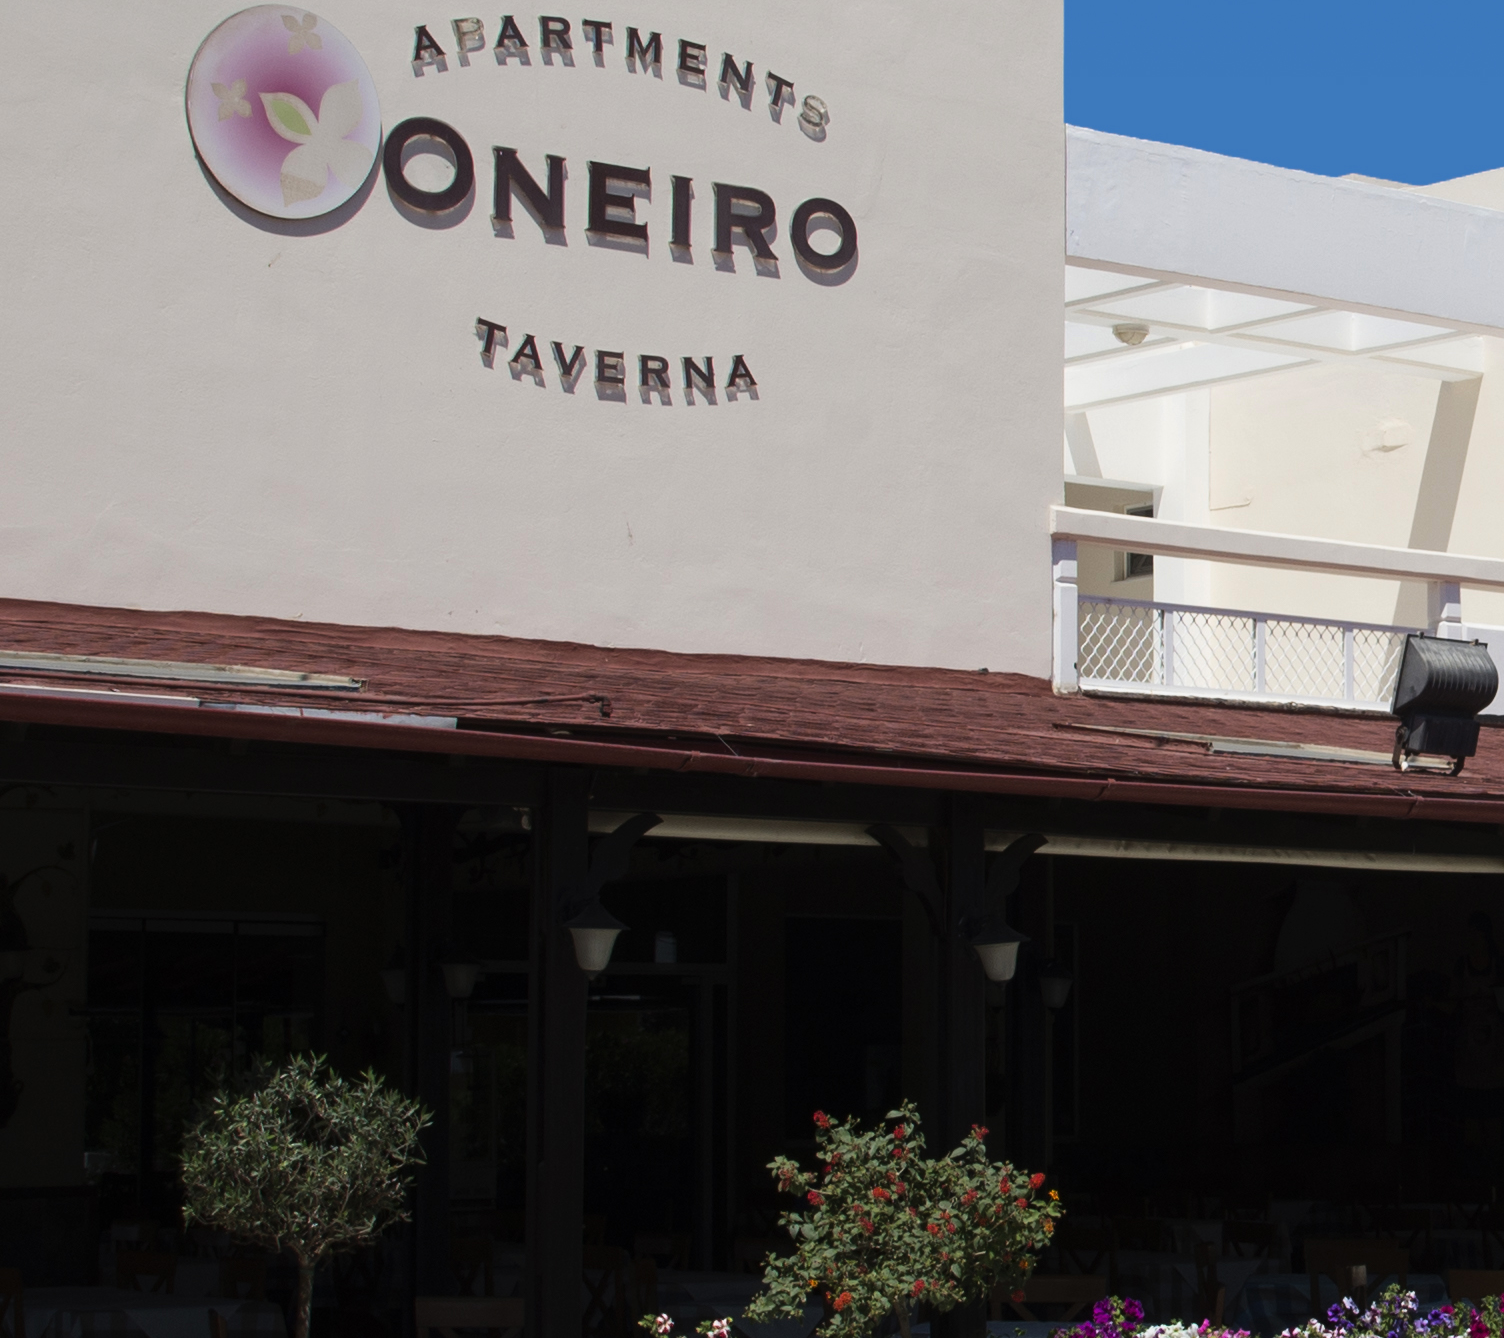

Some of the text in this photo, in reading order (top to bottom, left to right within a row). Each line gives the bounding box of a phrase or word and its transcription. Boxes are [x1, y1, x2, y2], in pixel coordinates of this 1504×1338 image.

[412, 14, 828, 131] APARTMENTS
[383, 117, 858, 271] ONEIRO
[475, 317, 758, 393] TAVERNA
